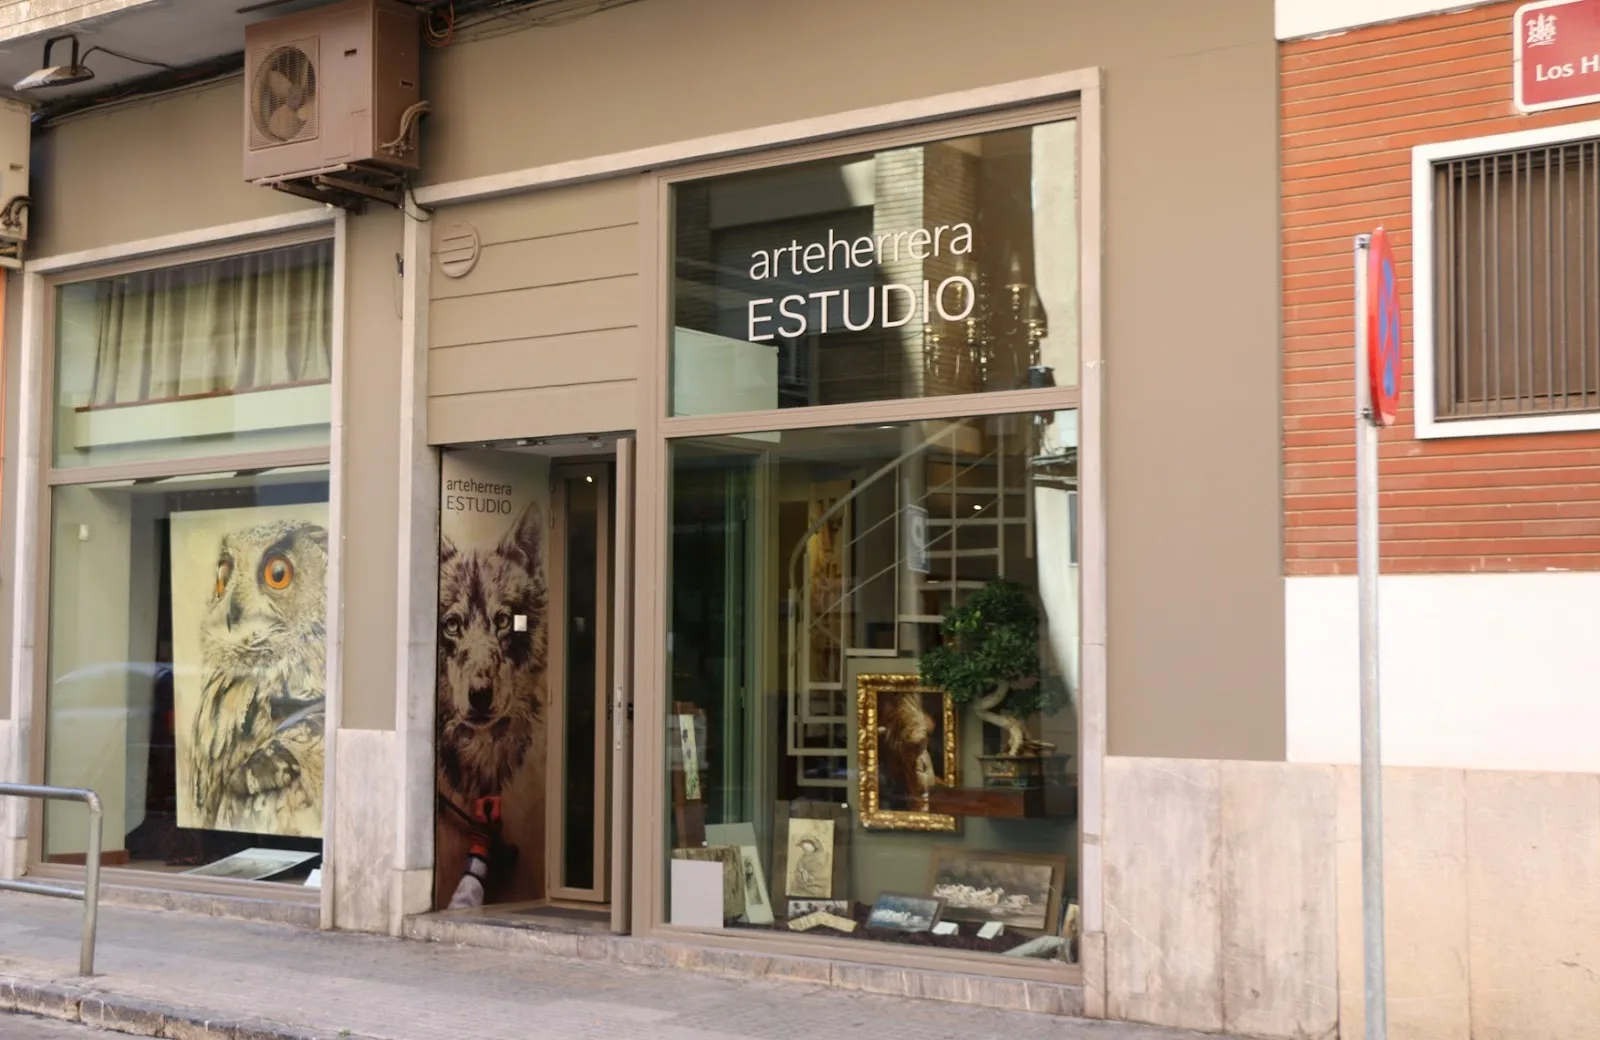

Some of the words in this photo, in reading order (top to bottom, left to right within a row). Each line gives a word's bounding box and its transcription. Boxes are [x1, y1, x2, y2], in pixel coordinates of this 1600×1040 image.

[749, 222, 973, 280] arteherrera
[748, 275, 976, 342] ESTUDIO
[446, 478, 512, 496] arteherrera
[446, 496, 512, 515] ESTUDIO
